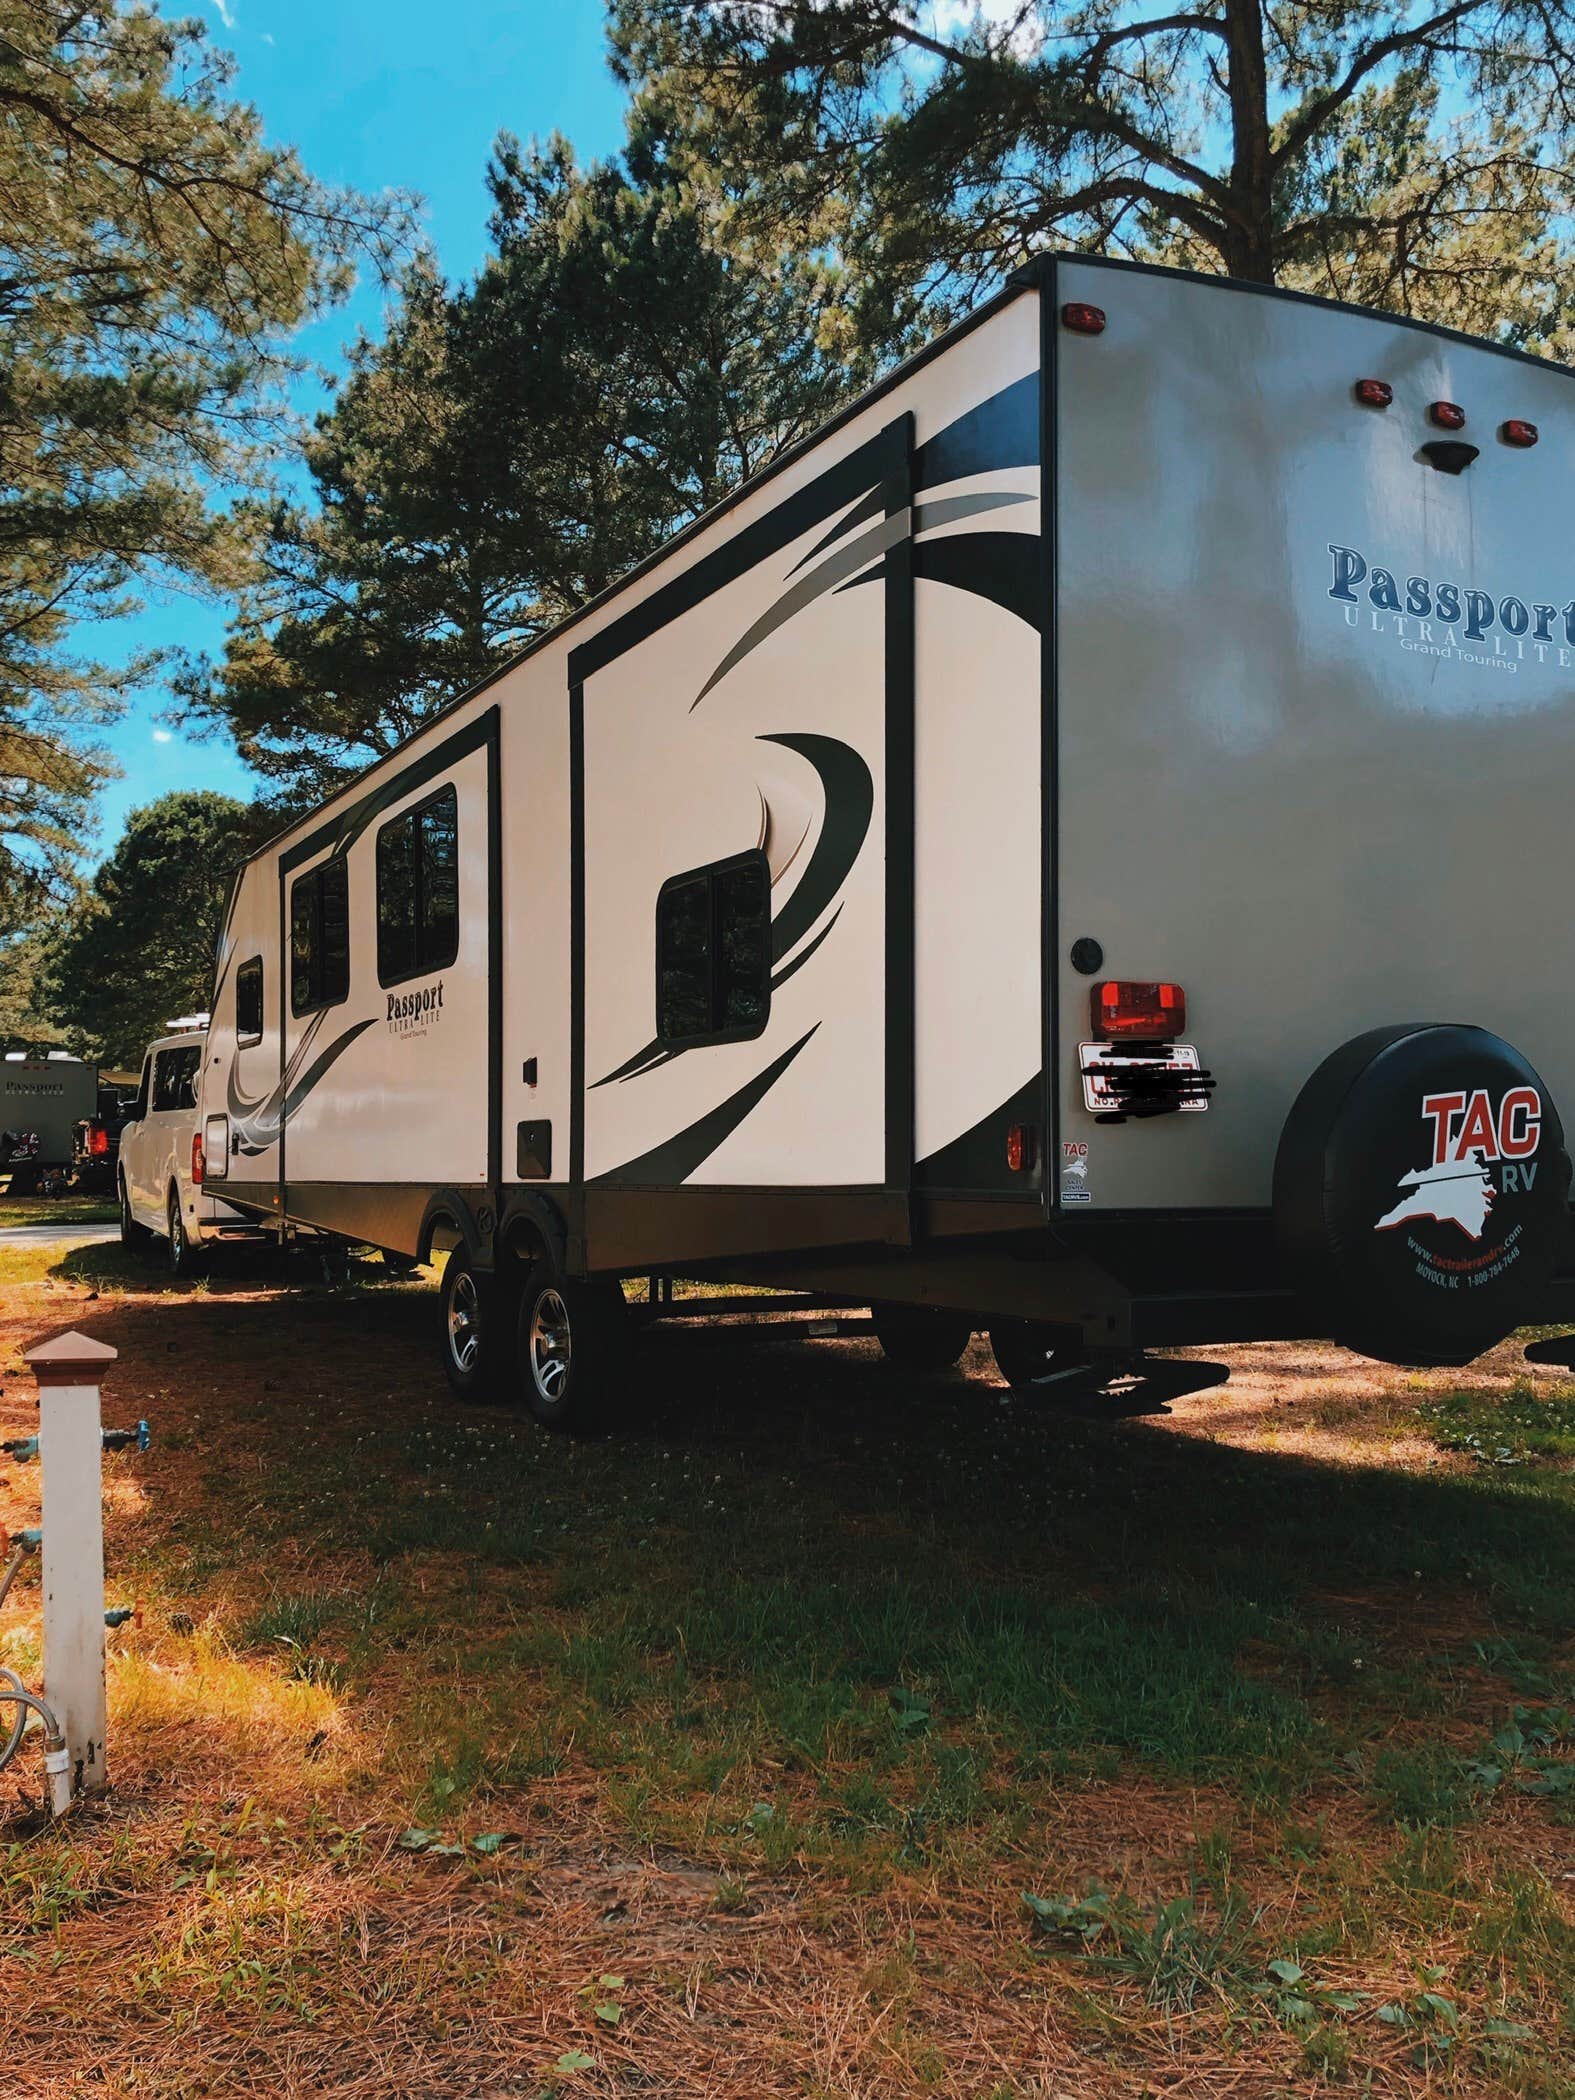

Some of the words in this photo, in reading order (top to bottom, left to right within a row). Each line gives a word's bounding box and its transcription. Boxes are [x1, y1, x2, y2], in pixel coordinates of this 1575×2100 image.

[1344, 605, 1458, 647] ULTRA
[1494, 635, 1571, 668] LITE
[1400, 638, 1451, 658] Grand
[1458, 649, 1518, 673] Touring
[387, 980, 443, 1021] Passport
[420, 1010, 440, 1025] LITE
[1421, 1086, 1541, 1167] TAC
[1063, 1143, 1088, 1157] TAC
[1502, 1162, 1538, 1193] RV
[1448, 1276, 1460, 1288] NC
